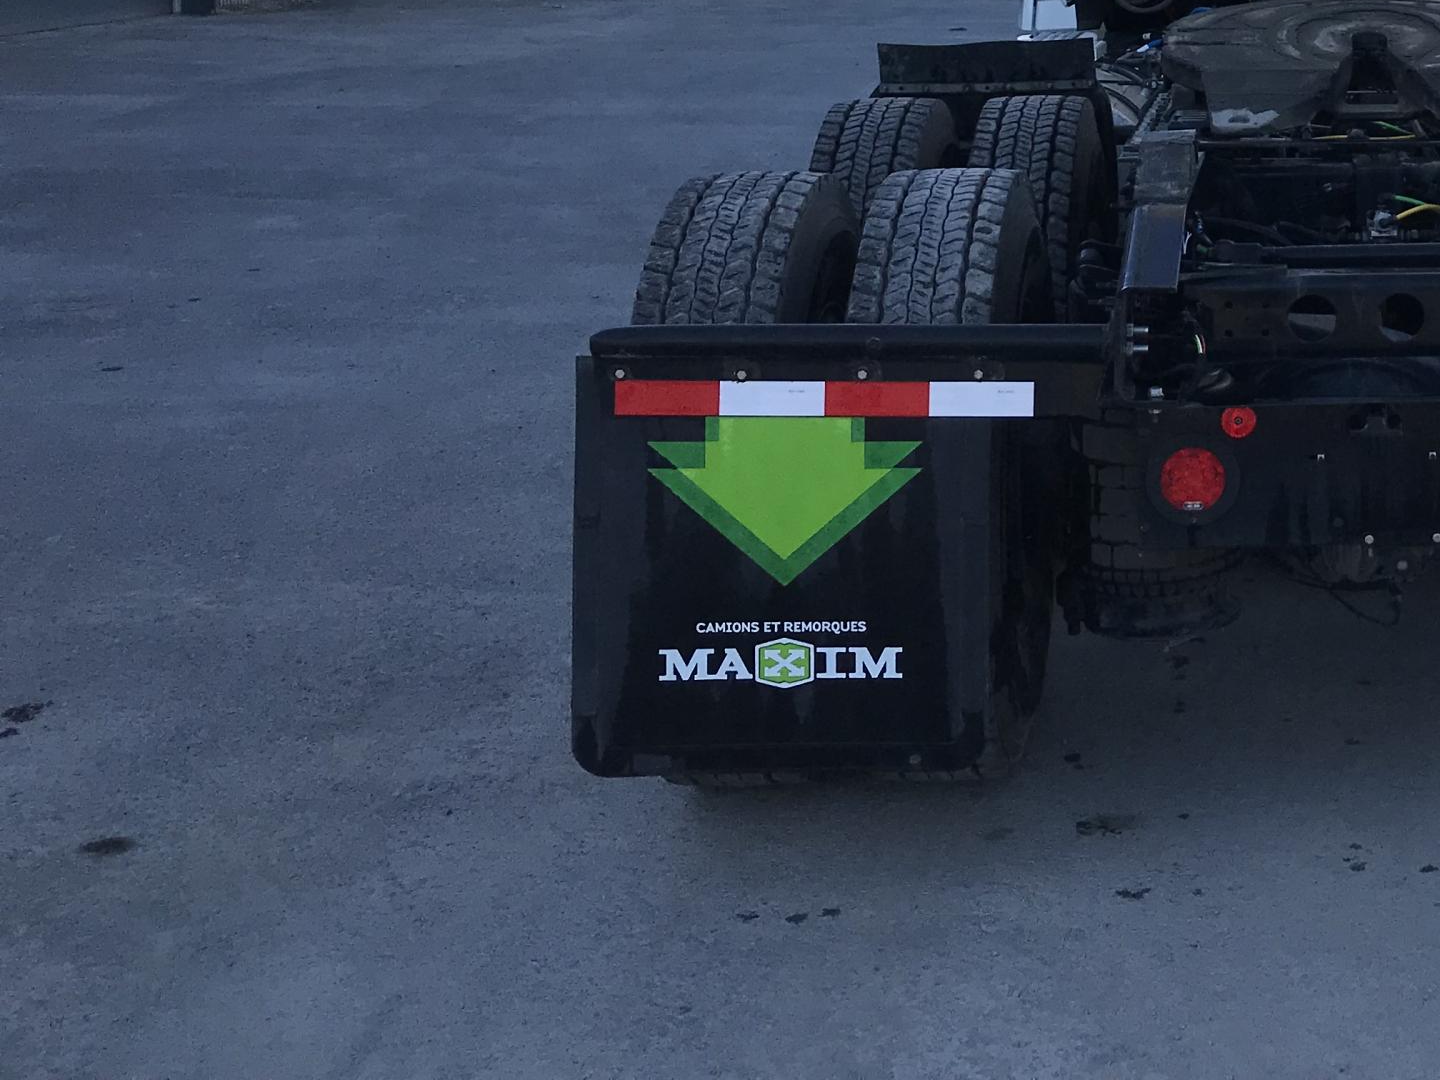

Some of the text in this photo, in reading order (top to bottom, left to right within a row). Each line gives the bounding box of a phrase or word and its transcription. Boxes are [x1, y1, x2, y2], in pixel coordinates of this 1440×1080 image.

[695, 621, 867, 634] CAMIONS ET REMORQUES
[658, 645, 904, 682] MAXIM
